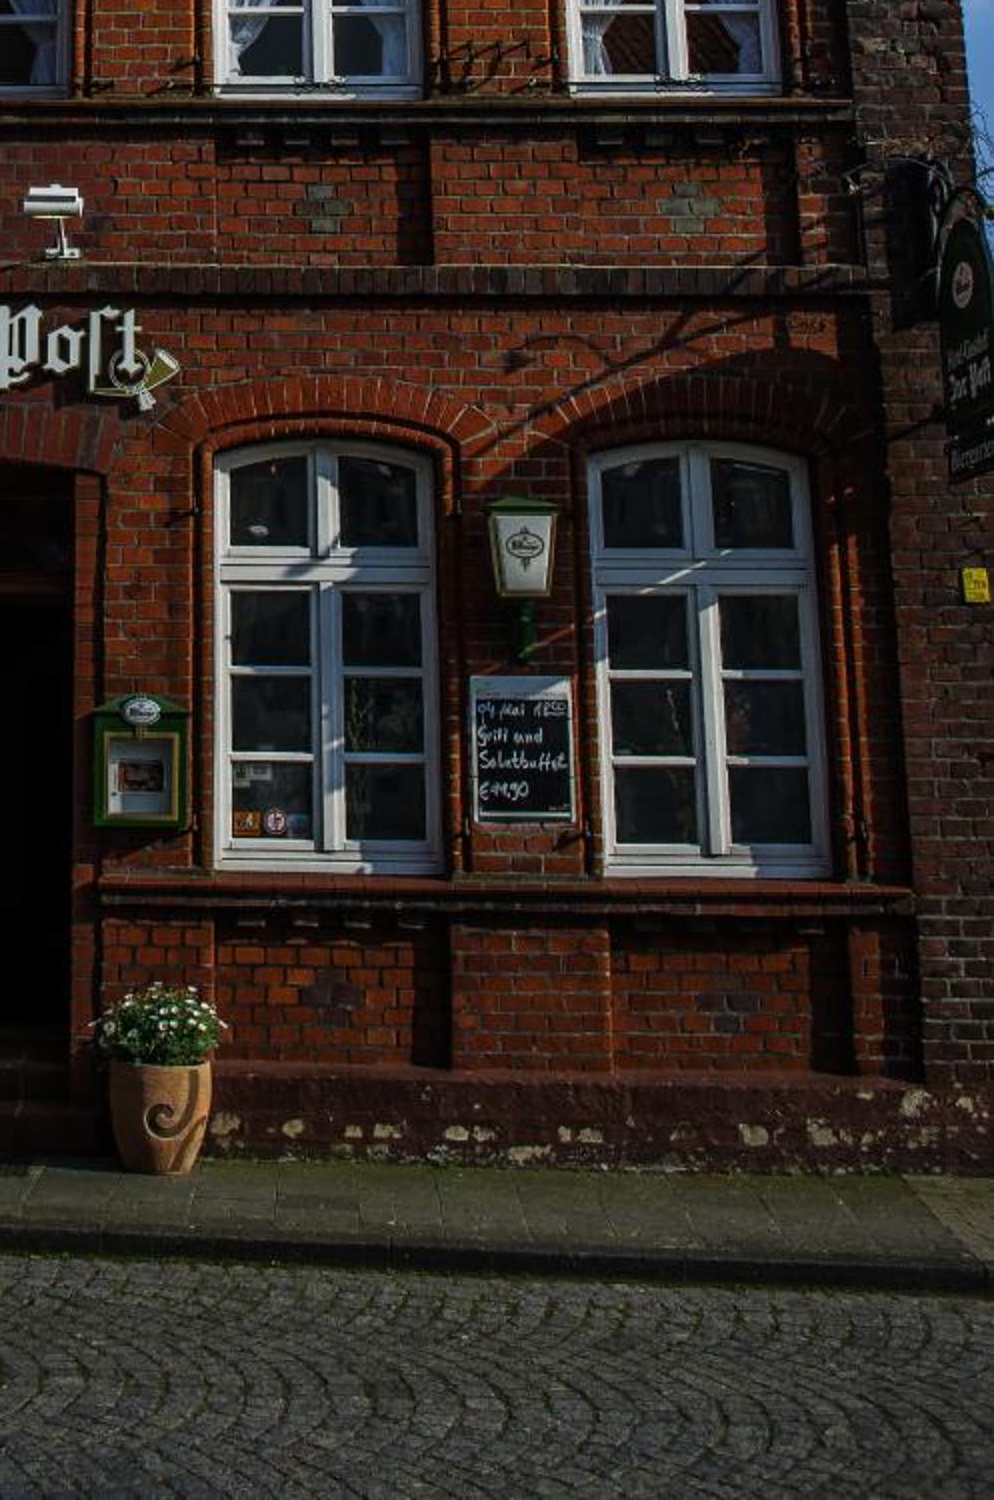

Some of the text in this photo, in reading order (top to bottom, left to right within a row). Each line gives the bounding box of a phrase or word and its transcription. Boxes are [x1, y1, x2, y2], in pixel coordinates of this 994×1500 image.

[478, 725, 543, 746] Grill und
[479, 750, 568, 772] Salatbuffet
